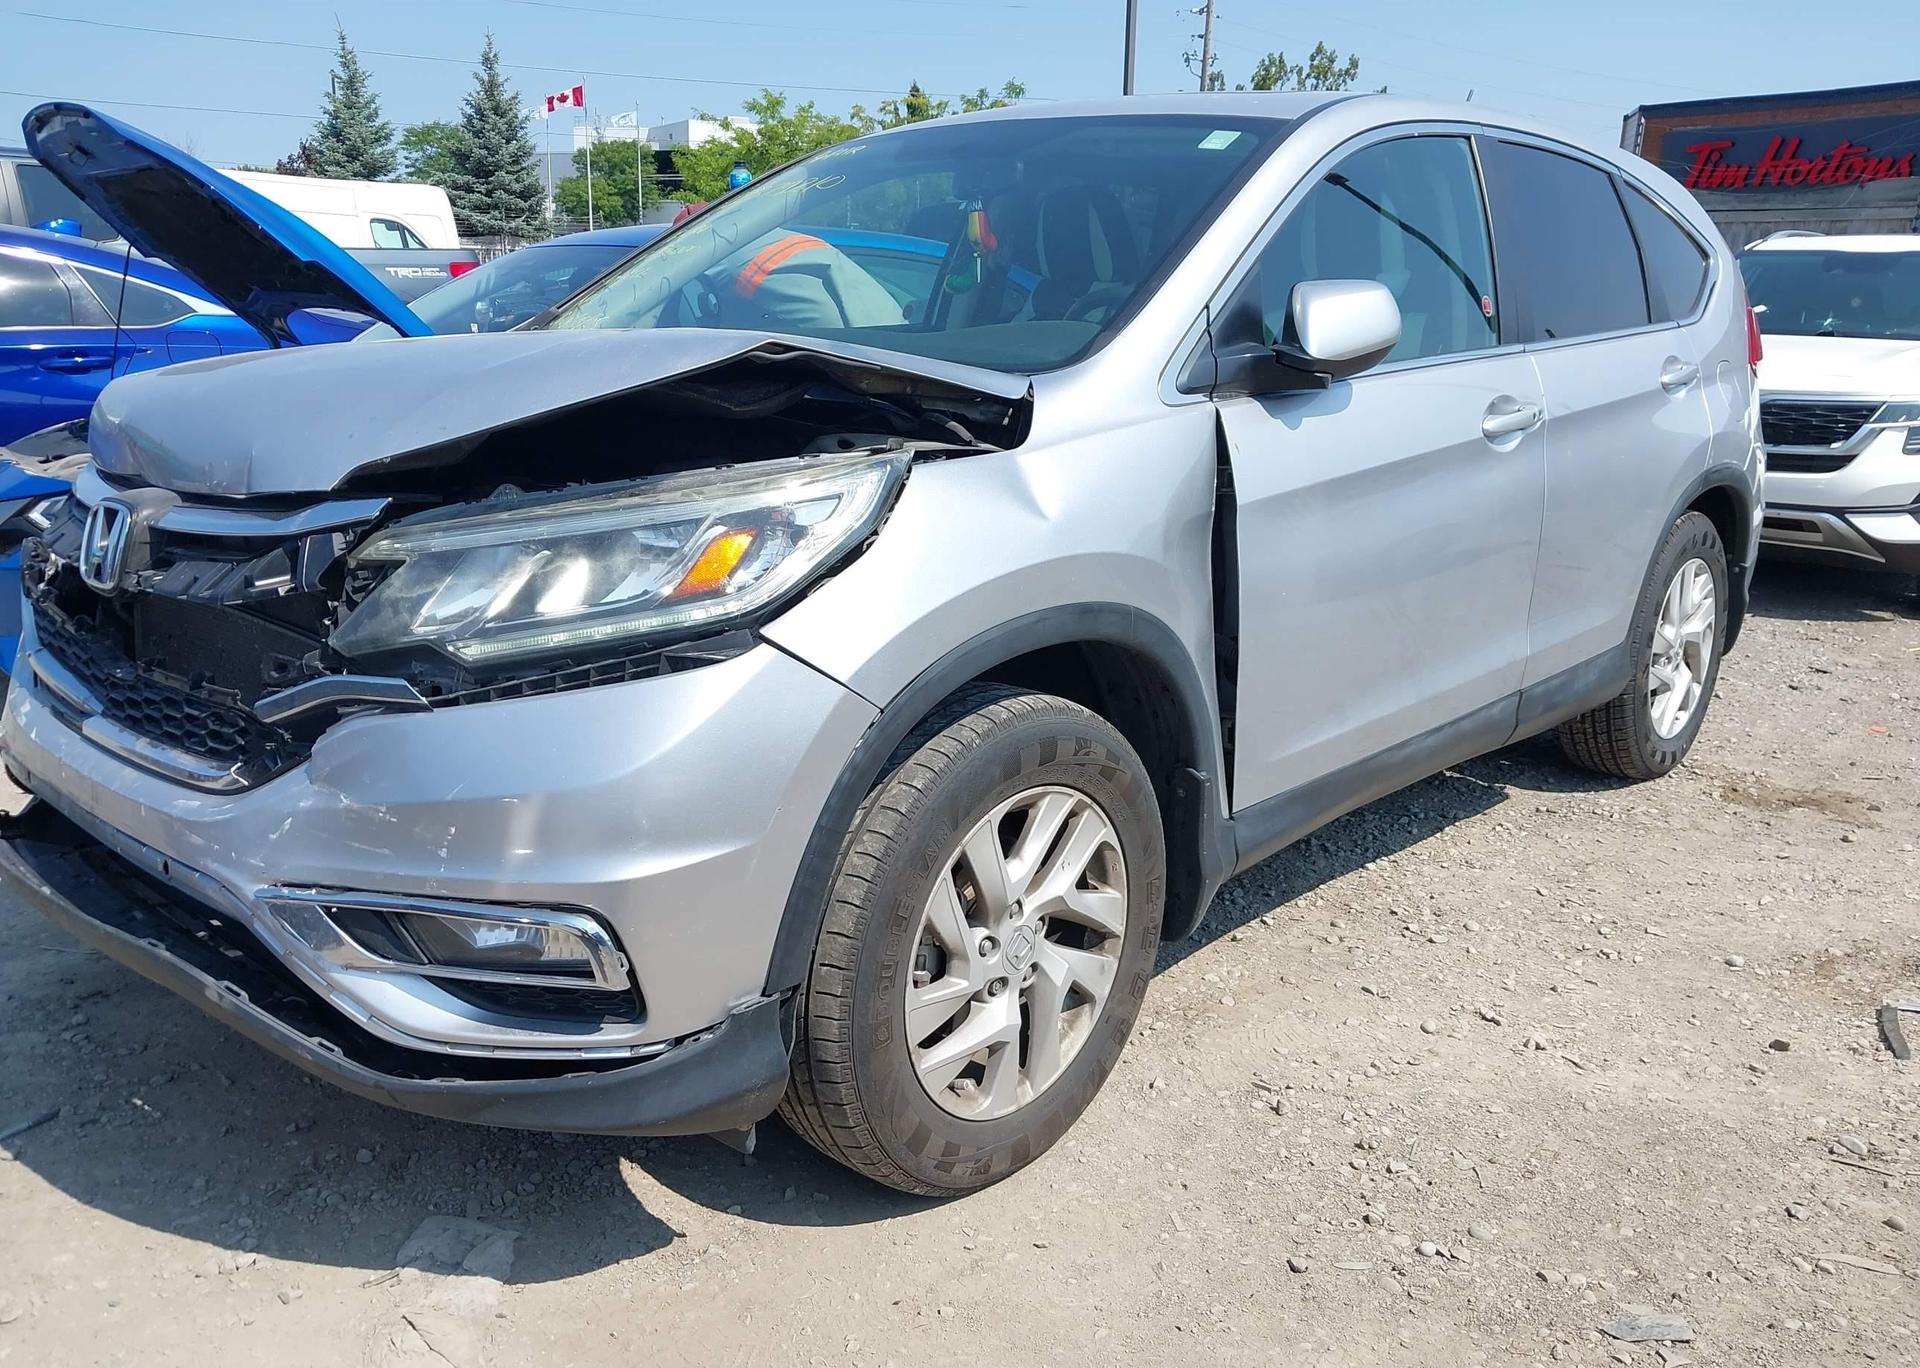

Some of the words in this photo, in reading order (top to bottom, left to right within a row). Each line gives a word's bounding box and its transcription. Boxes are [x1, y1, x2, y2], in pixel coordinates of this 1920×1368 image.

[1685, 141, 1750, 188] Tim
[1752, 135, 1915, 187] Hortons
[385, 267, 422, 279] TRD
